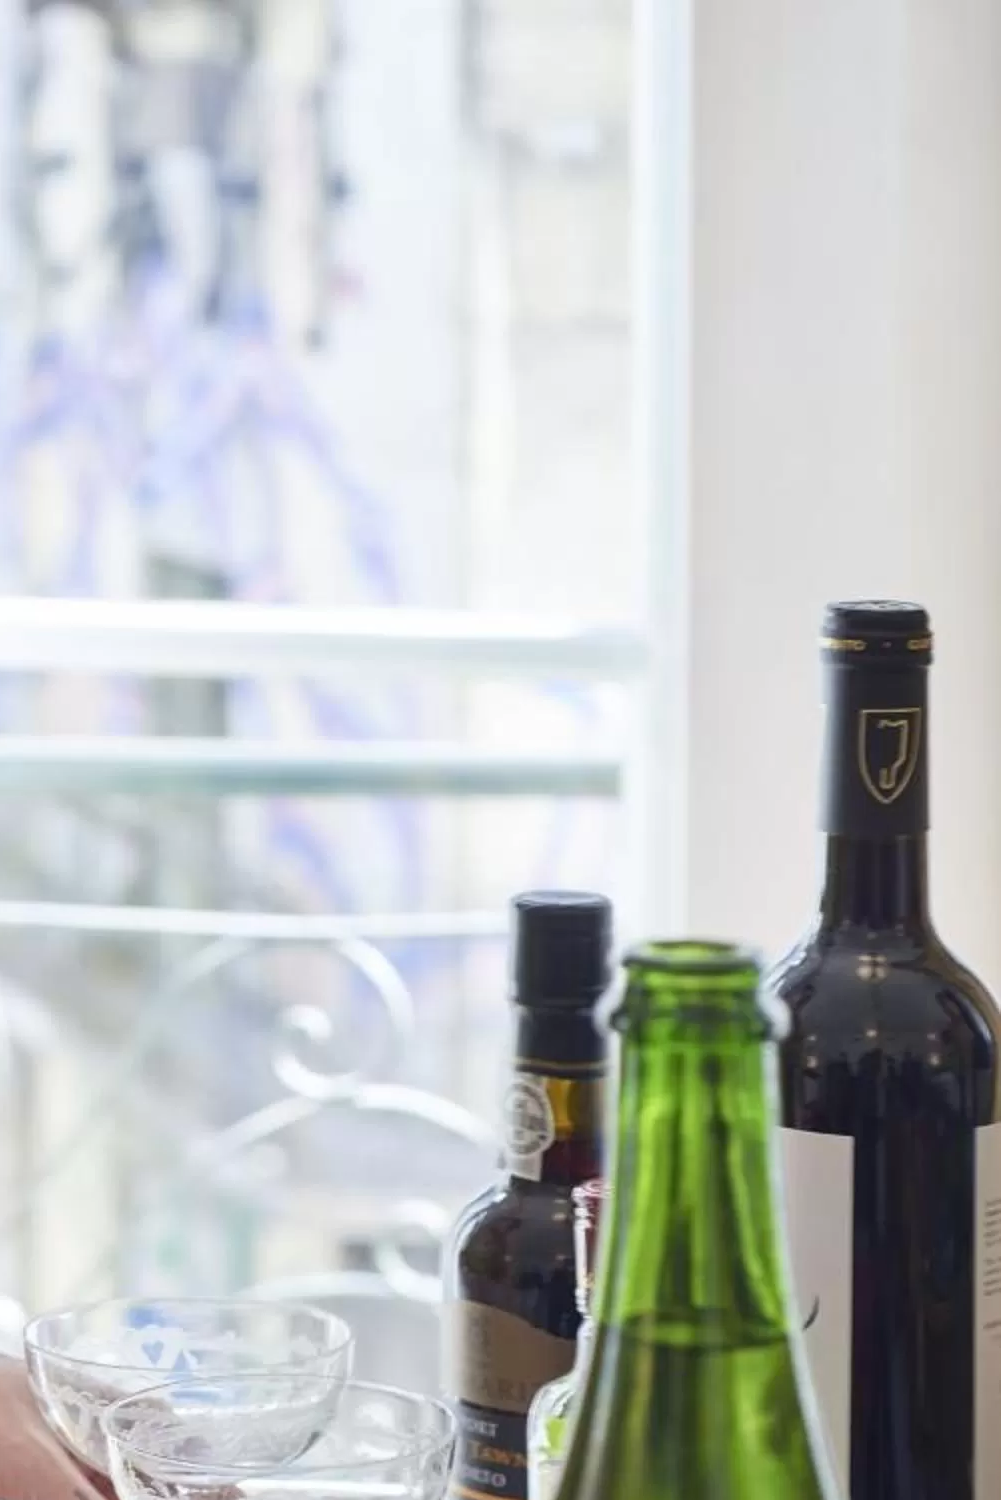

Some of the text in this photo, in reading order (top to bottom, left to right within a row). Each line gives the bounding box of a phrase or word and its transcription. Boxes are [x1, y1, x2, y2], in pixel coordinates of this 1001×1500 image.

[461, 1415, 499, 1438] ORT
[470, 1442, 529, 1469] TAWN
[458, 1463, 507, 1488] ORTO
